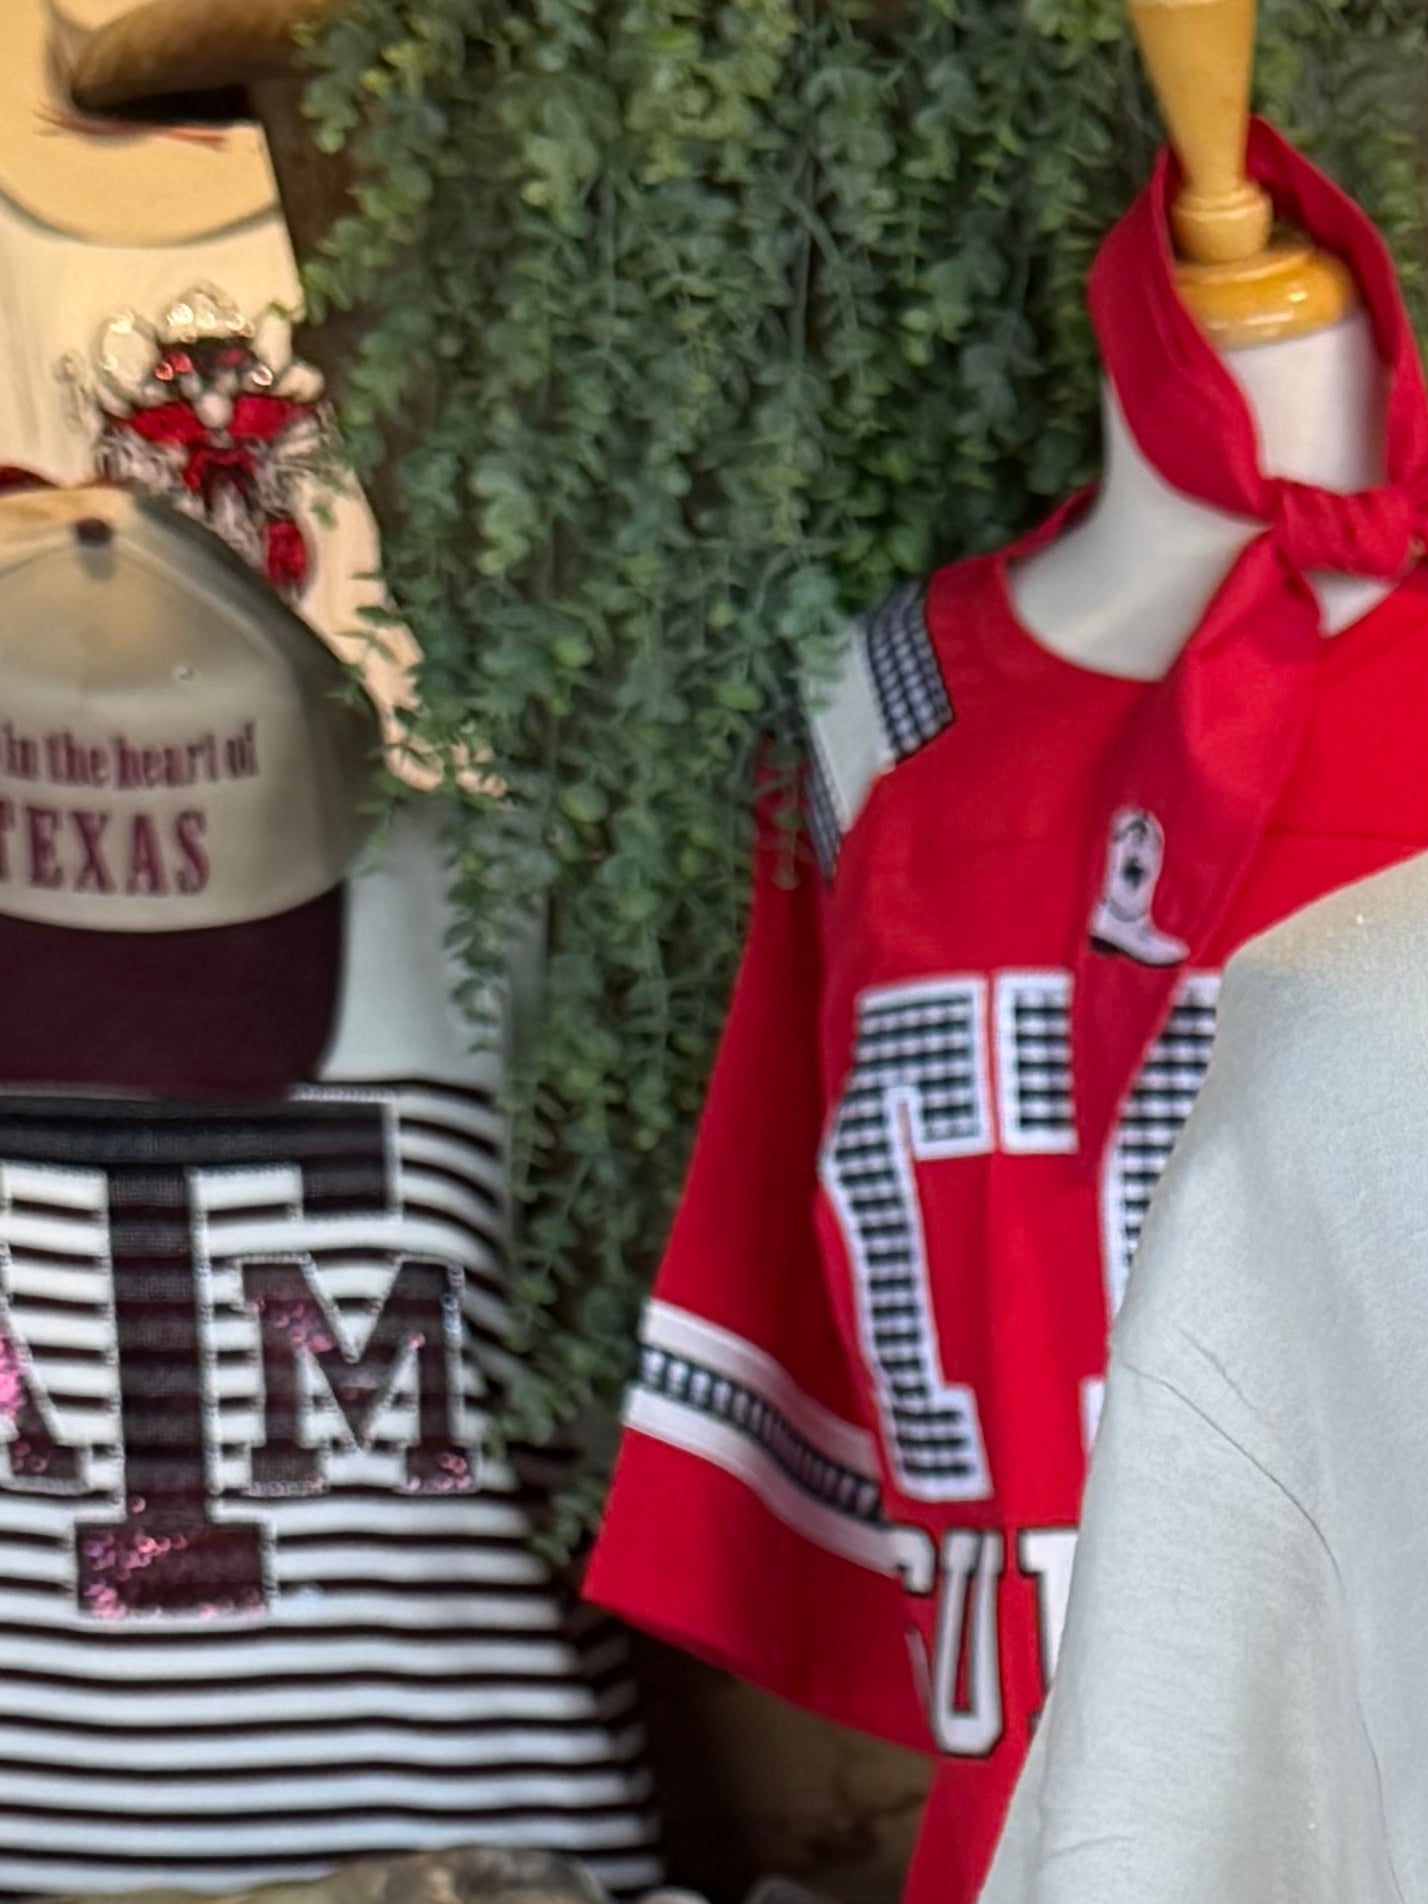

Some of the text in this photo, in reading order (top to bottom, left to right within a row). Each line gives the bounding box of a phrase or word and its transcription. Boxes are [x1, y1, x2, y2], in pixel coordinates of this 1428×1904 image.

[46, 731, 109, 788] the
[113, 733, 219, 790] heart
[225, 720, 259, 778] of
